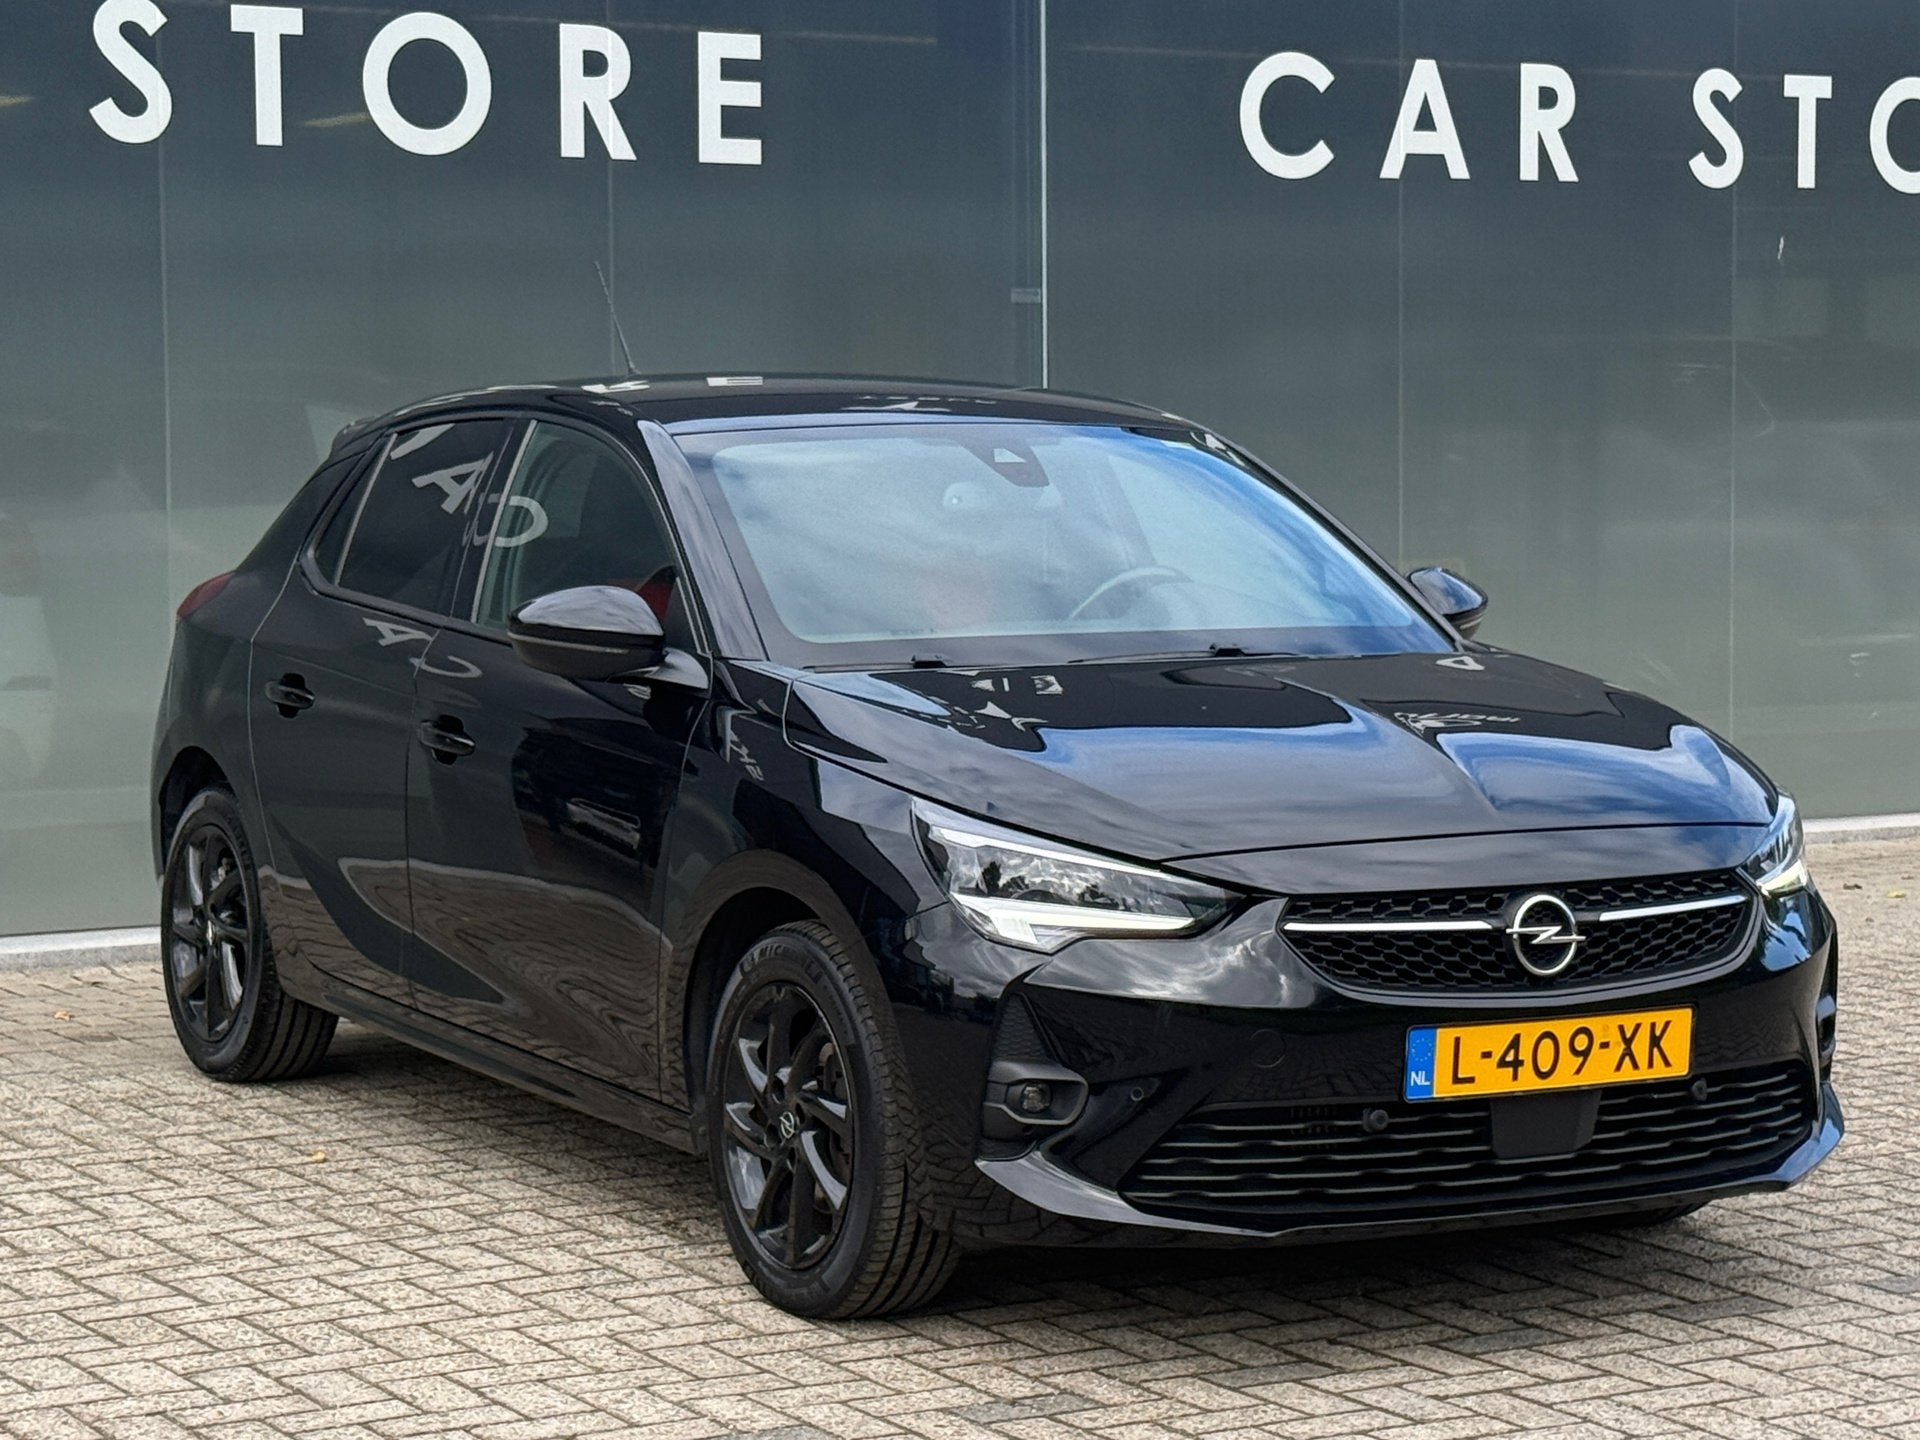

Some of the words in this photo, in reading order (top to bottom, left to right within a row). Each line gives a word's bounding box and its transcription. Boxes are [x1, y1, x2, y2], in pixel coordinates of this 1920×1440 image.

[88, 0, 763, 165] STORE
[1239, 51, 1579, 183] CAR
[1410, 1070, 1431, 1087] NL
[1451, 1019, 1673, 1086] L-409-XK
